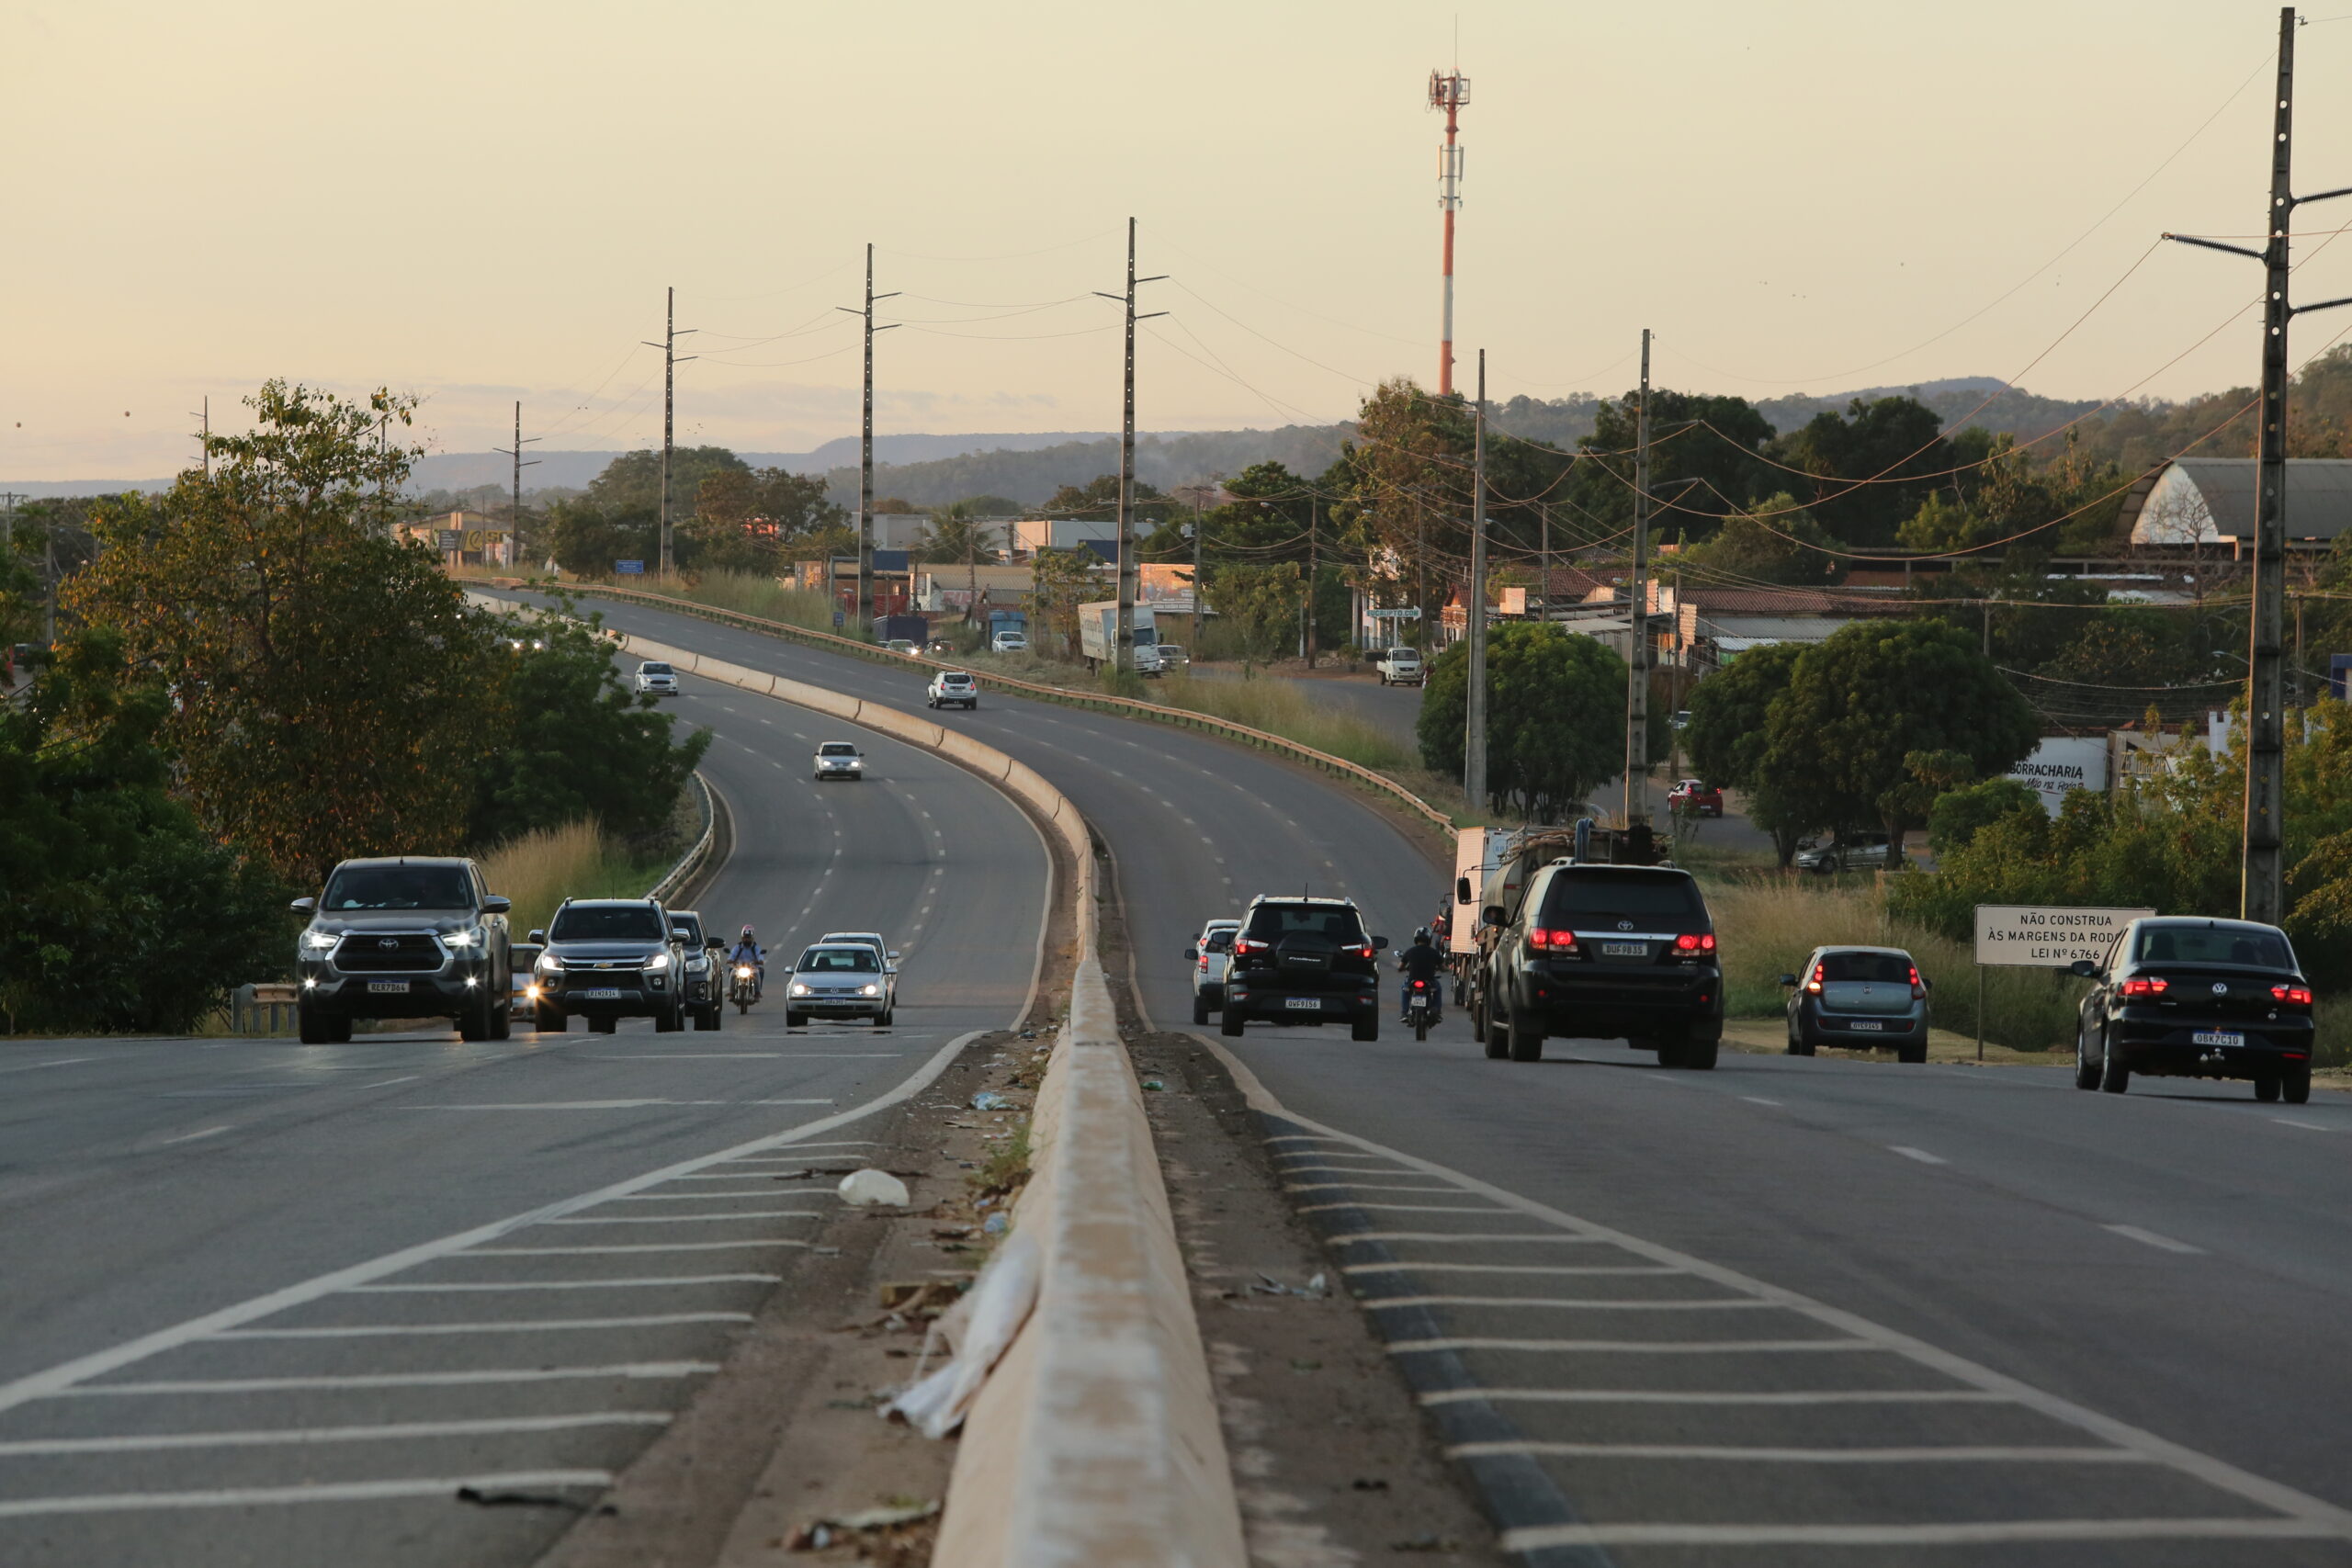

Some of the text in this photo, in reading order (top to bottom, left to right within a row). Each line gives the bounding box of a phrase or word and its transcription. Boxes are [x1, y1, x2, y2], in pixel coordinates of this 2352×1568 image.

[2009, 763, 2084, 780] BORRACHARIA
[2020, 912, 2112, 926] NÃO CONSTRUA
[1987, 927, 2004, 941] ÀS
[2008, 931, 2066, 942] MARGENS
[2070, 932, 2086, 942] DA
[2030, 948, 2049, 958] LEI
[2070, 949, 2100, 959] 6.766
